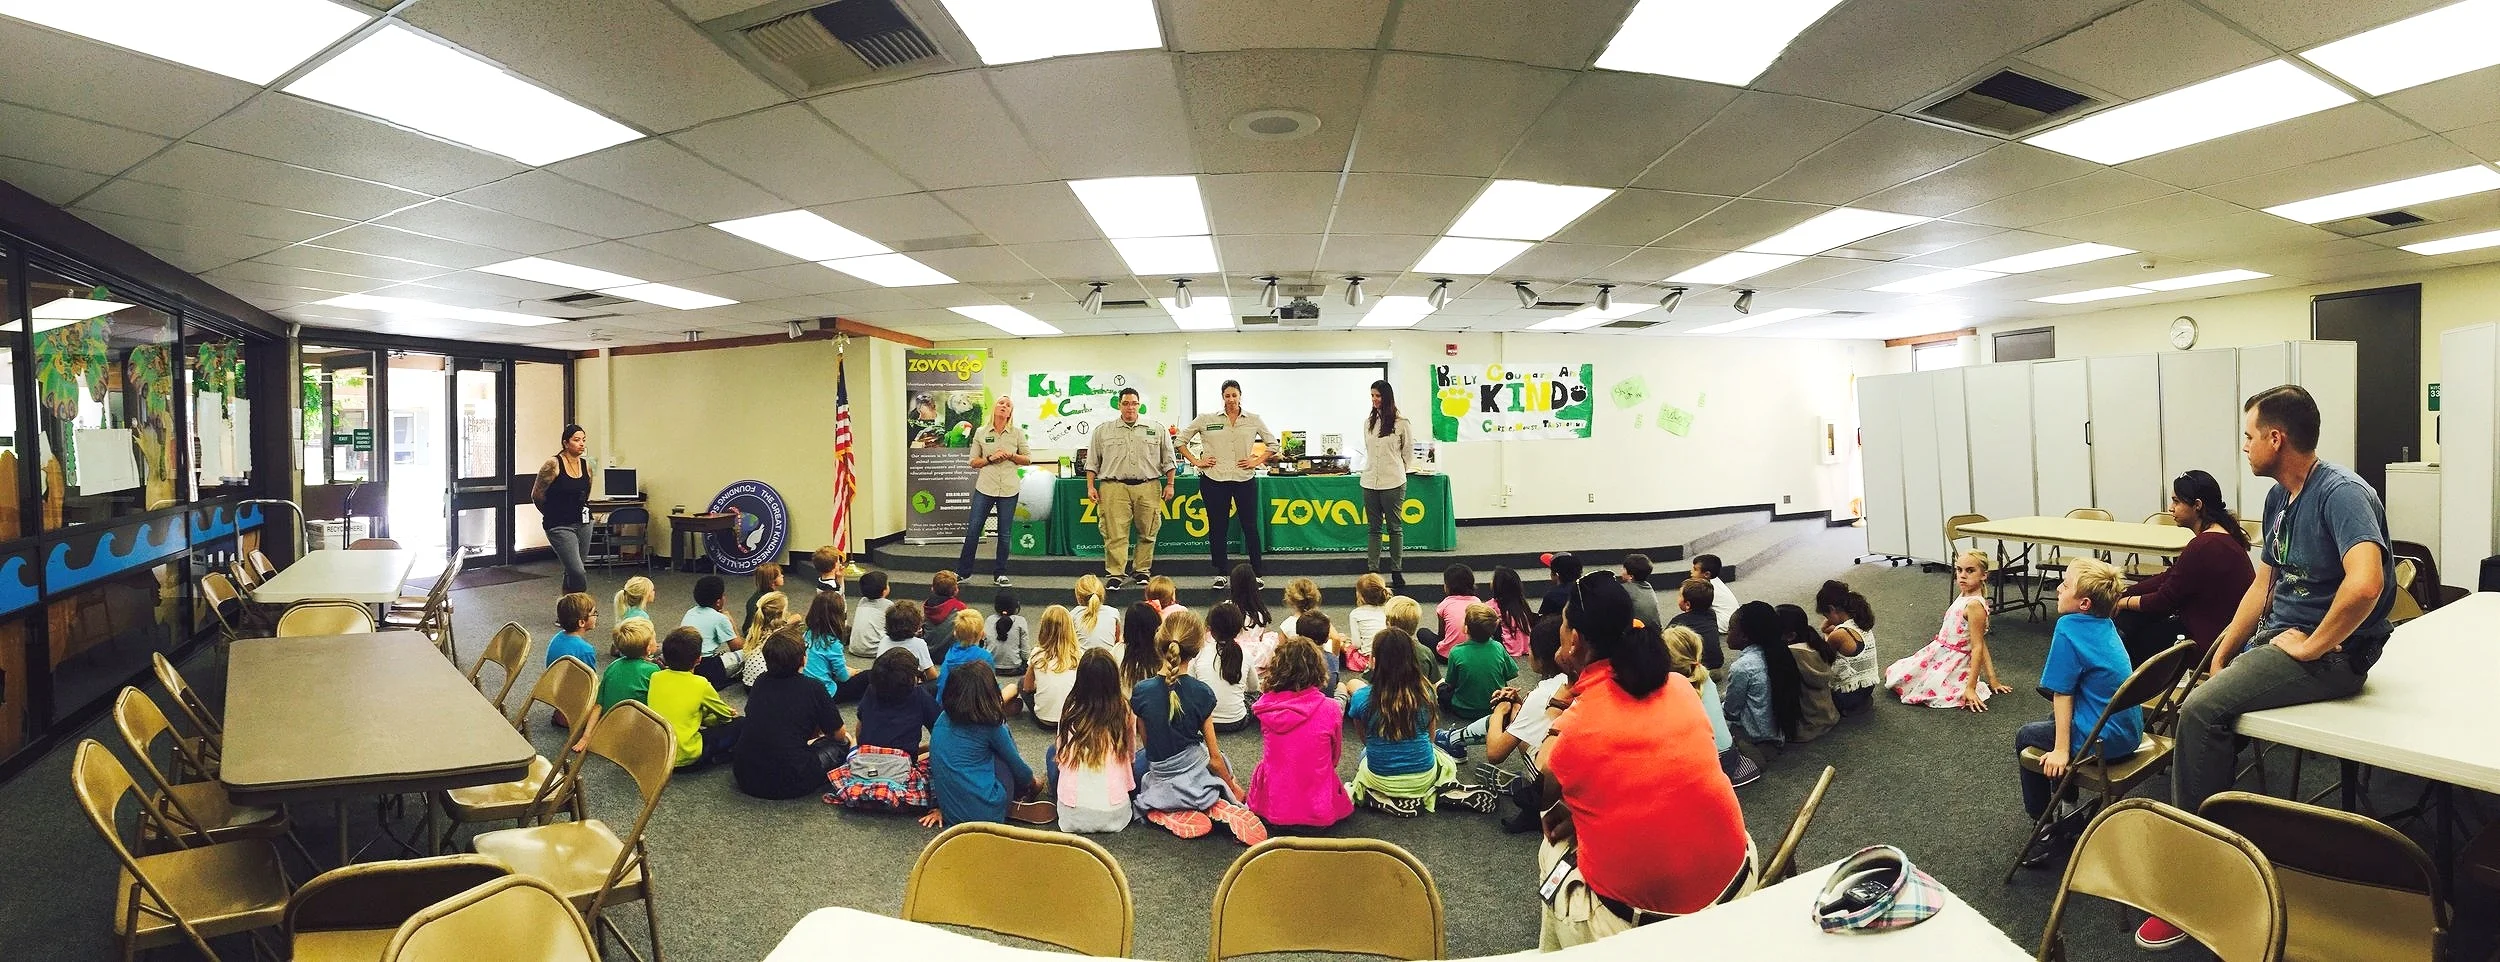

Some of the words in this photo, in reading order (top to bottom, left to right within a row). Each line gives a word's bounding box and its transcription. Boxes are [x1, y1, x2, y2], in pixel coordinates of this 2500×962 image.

[1480, 380, 1569, 413] KIND
[718, 485, 756, 505] FOUNDING
[760, 489, 774, 504] THE
[771, 502, 782, 530] GREAT
[752, 530, 781, 566] KINDNESS
